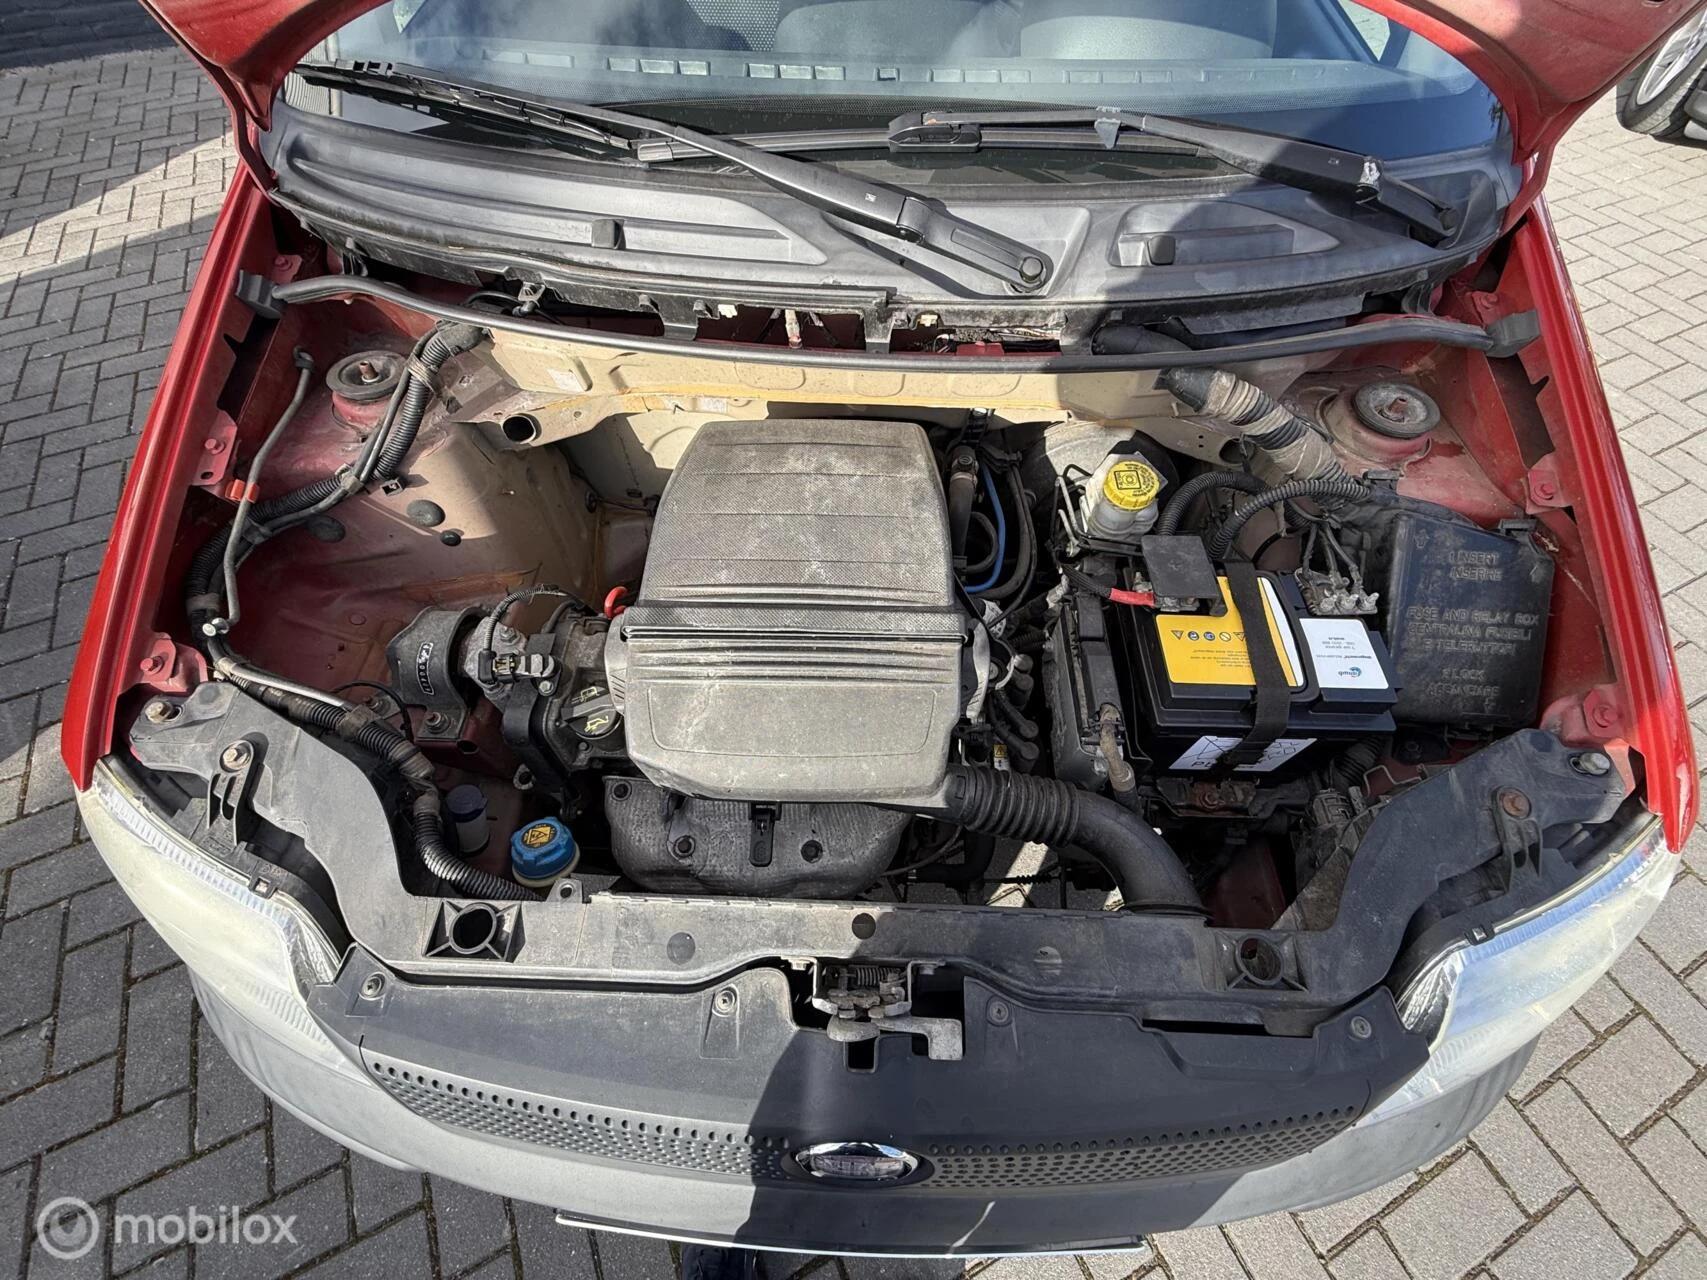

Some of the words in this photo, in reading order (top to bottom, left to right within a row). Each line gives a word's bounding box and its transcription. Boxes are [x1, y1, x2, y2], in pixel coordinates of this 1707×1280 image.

[1406, 606, 1439, 620] FUSE
[1442, 608, 1468, 621] AND
[1471, 609, 1511, 623] RELAY
[1514, 612, 1539, 625] BOX
[1408, 622, 1481, 638] CENTRALINA
